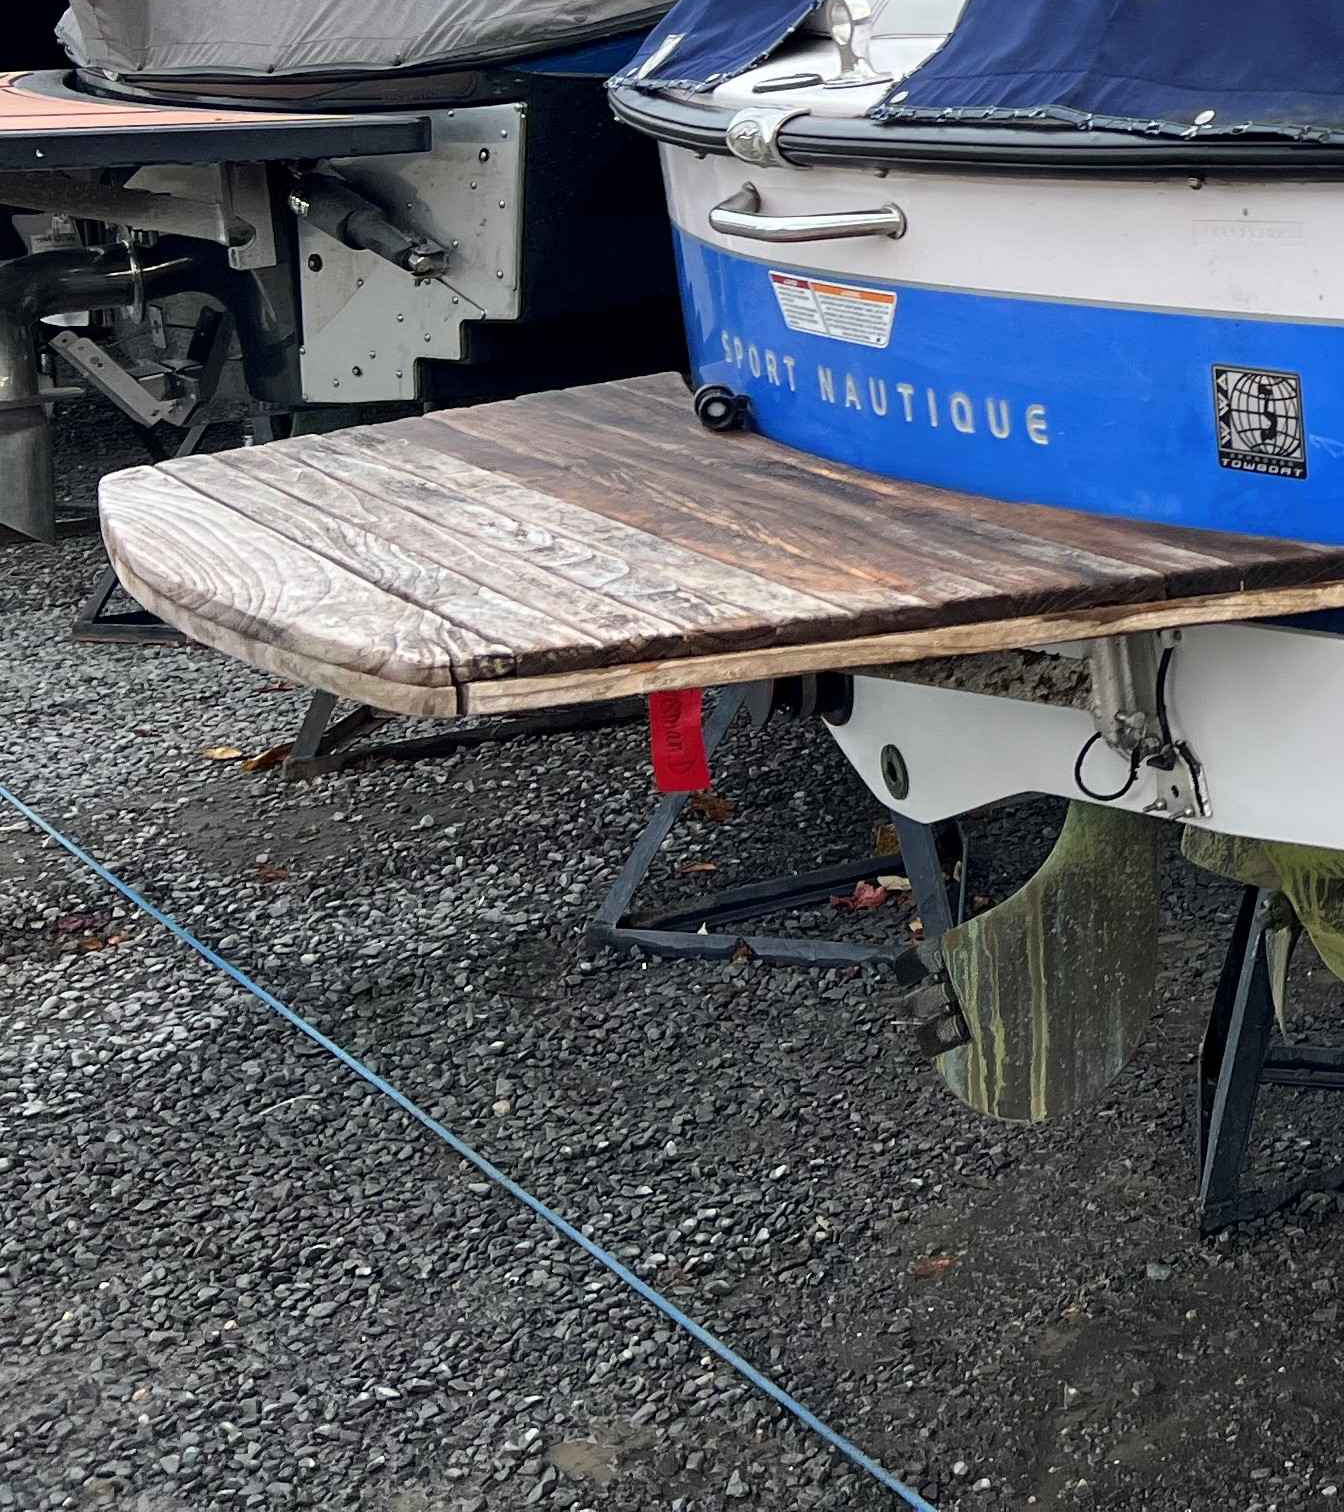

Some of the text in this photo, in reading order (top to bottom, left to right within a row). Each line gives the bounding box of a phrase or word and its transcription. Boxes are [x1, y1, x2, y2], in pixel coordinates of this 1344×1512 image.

[721, 329, 1049, 446] SPORT NAUTIQUE
[1221, 458, 1304, 477] TOWBOAT
